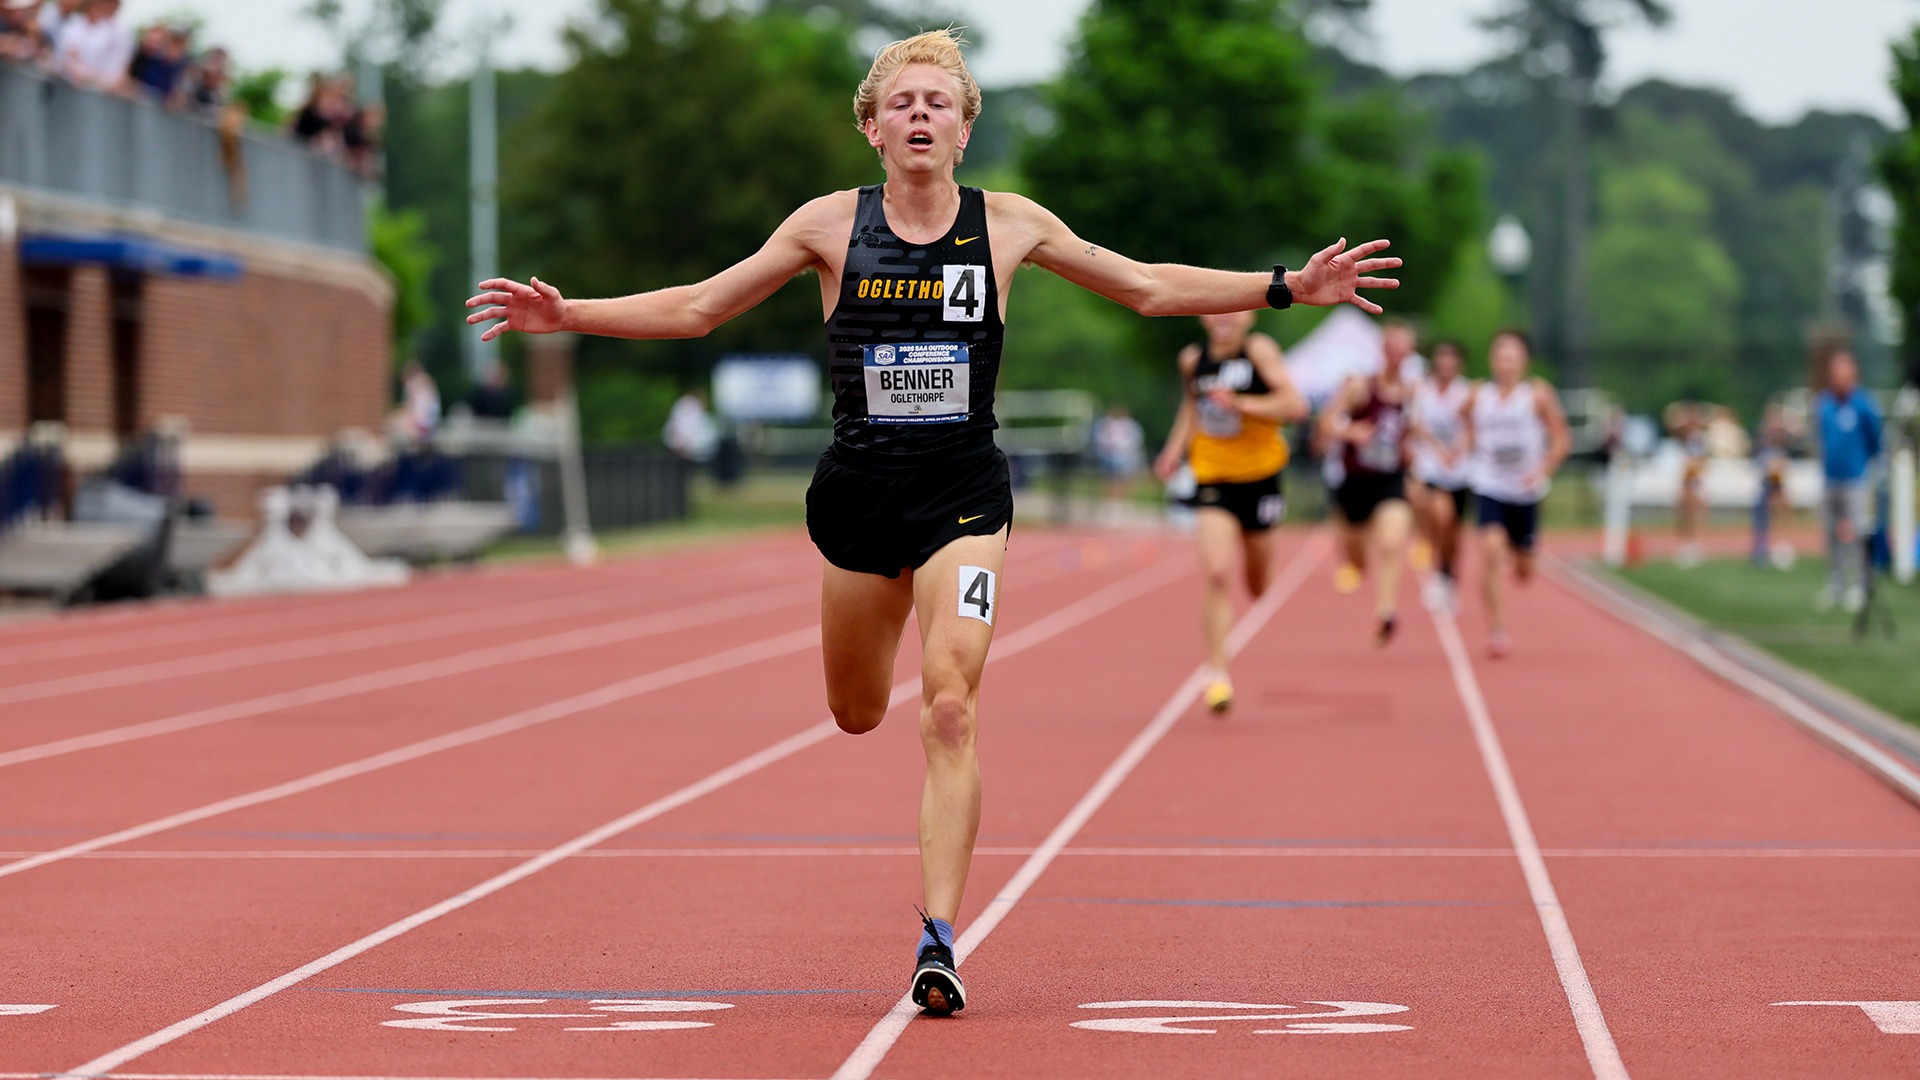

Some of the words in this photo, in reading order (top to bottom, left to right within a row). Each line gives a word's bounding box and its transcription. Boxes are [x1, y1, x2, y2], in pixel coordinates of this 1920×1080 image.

[857, 279, 943, 299] OGLETHO
[948, 269, 979, 318] 4
[877, 352, 893, 360] SAA
[903, 356, 956, 364] CHAMPIONSHIPS
[880, 368, 954, 390] BENNER
[891, 392, 944, 403] OGLETHORPE
[964, 571, 990, 618] 4
[1068, 999, 1415, 1035] 2
